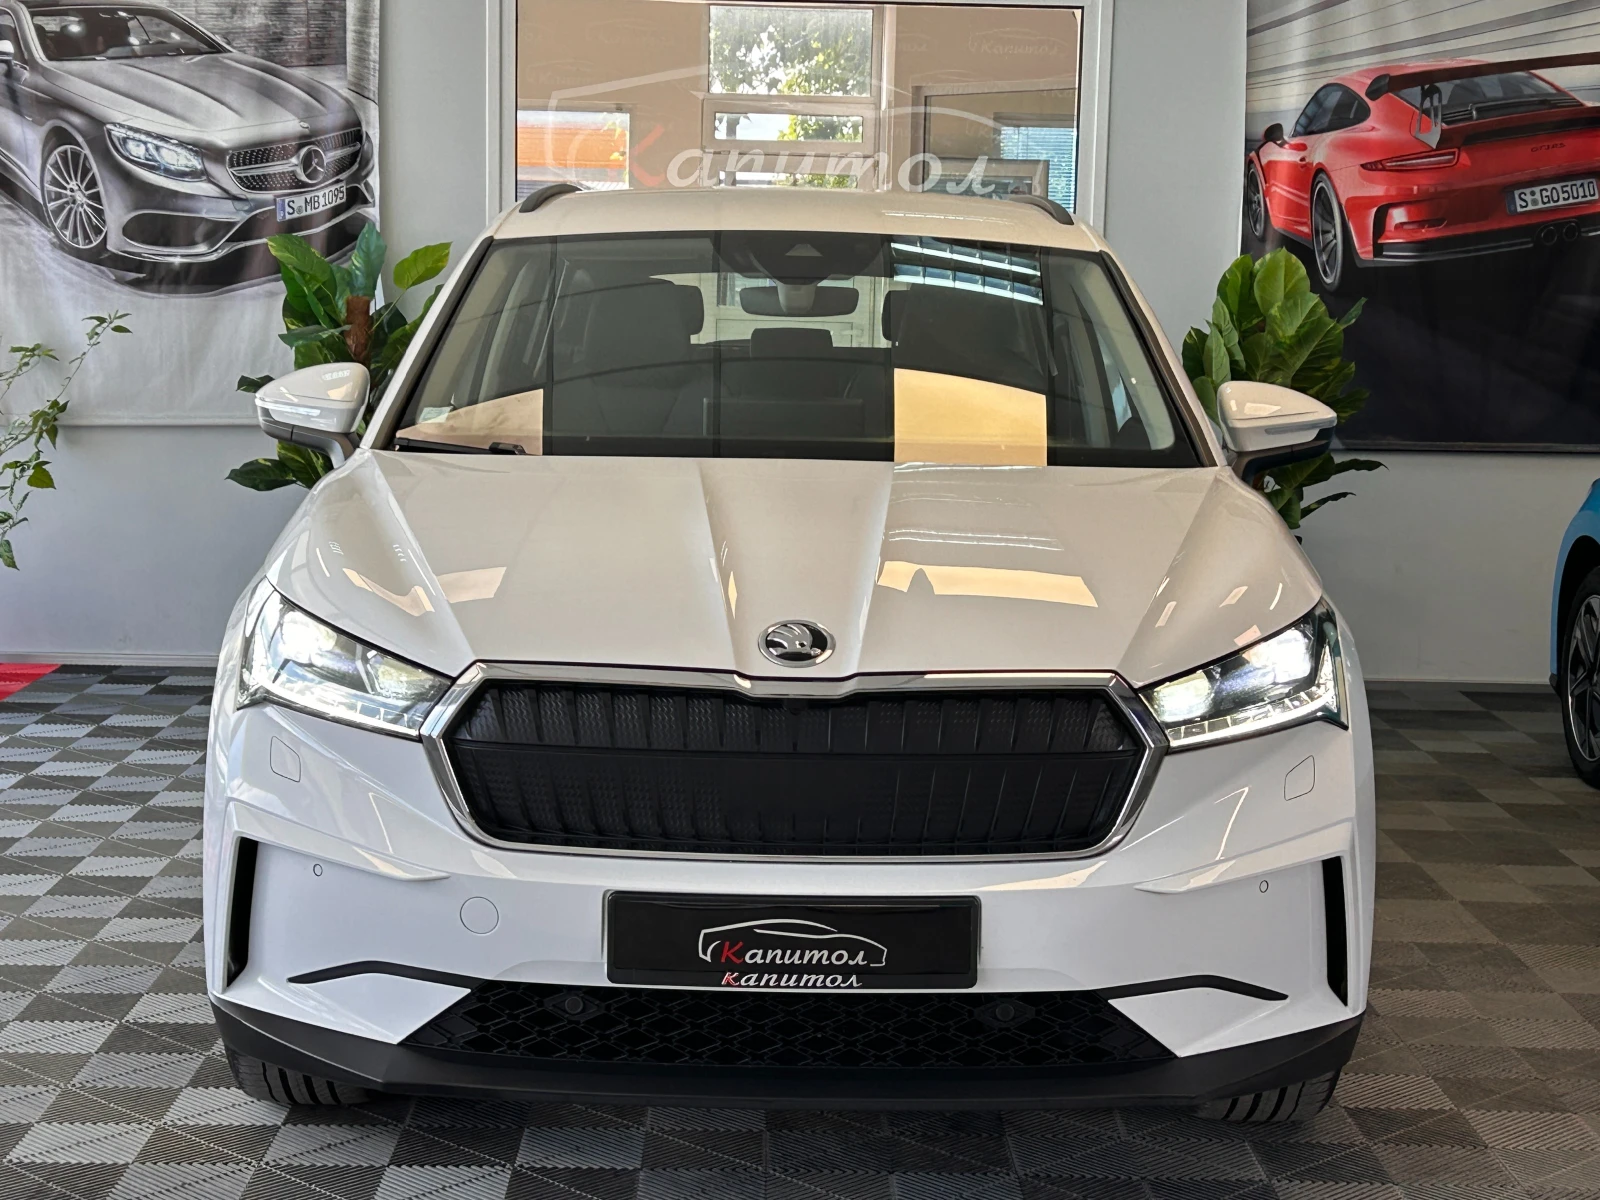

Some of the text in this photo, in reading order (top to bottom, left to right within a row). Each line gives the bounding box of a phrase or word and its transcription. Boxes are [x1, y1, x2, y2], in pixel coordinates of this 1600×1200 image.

[287, 186, 345, 215] S MB 1095
[1518, 192, 1529, 209] S
[720, 941, 868, 964] Капитол
[721, 971, 863, 988] Капитол
